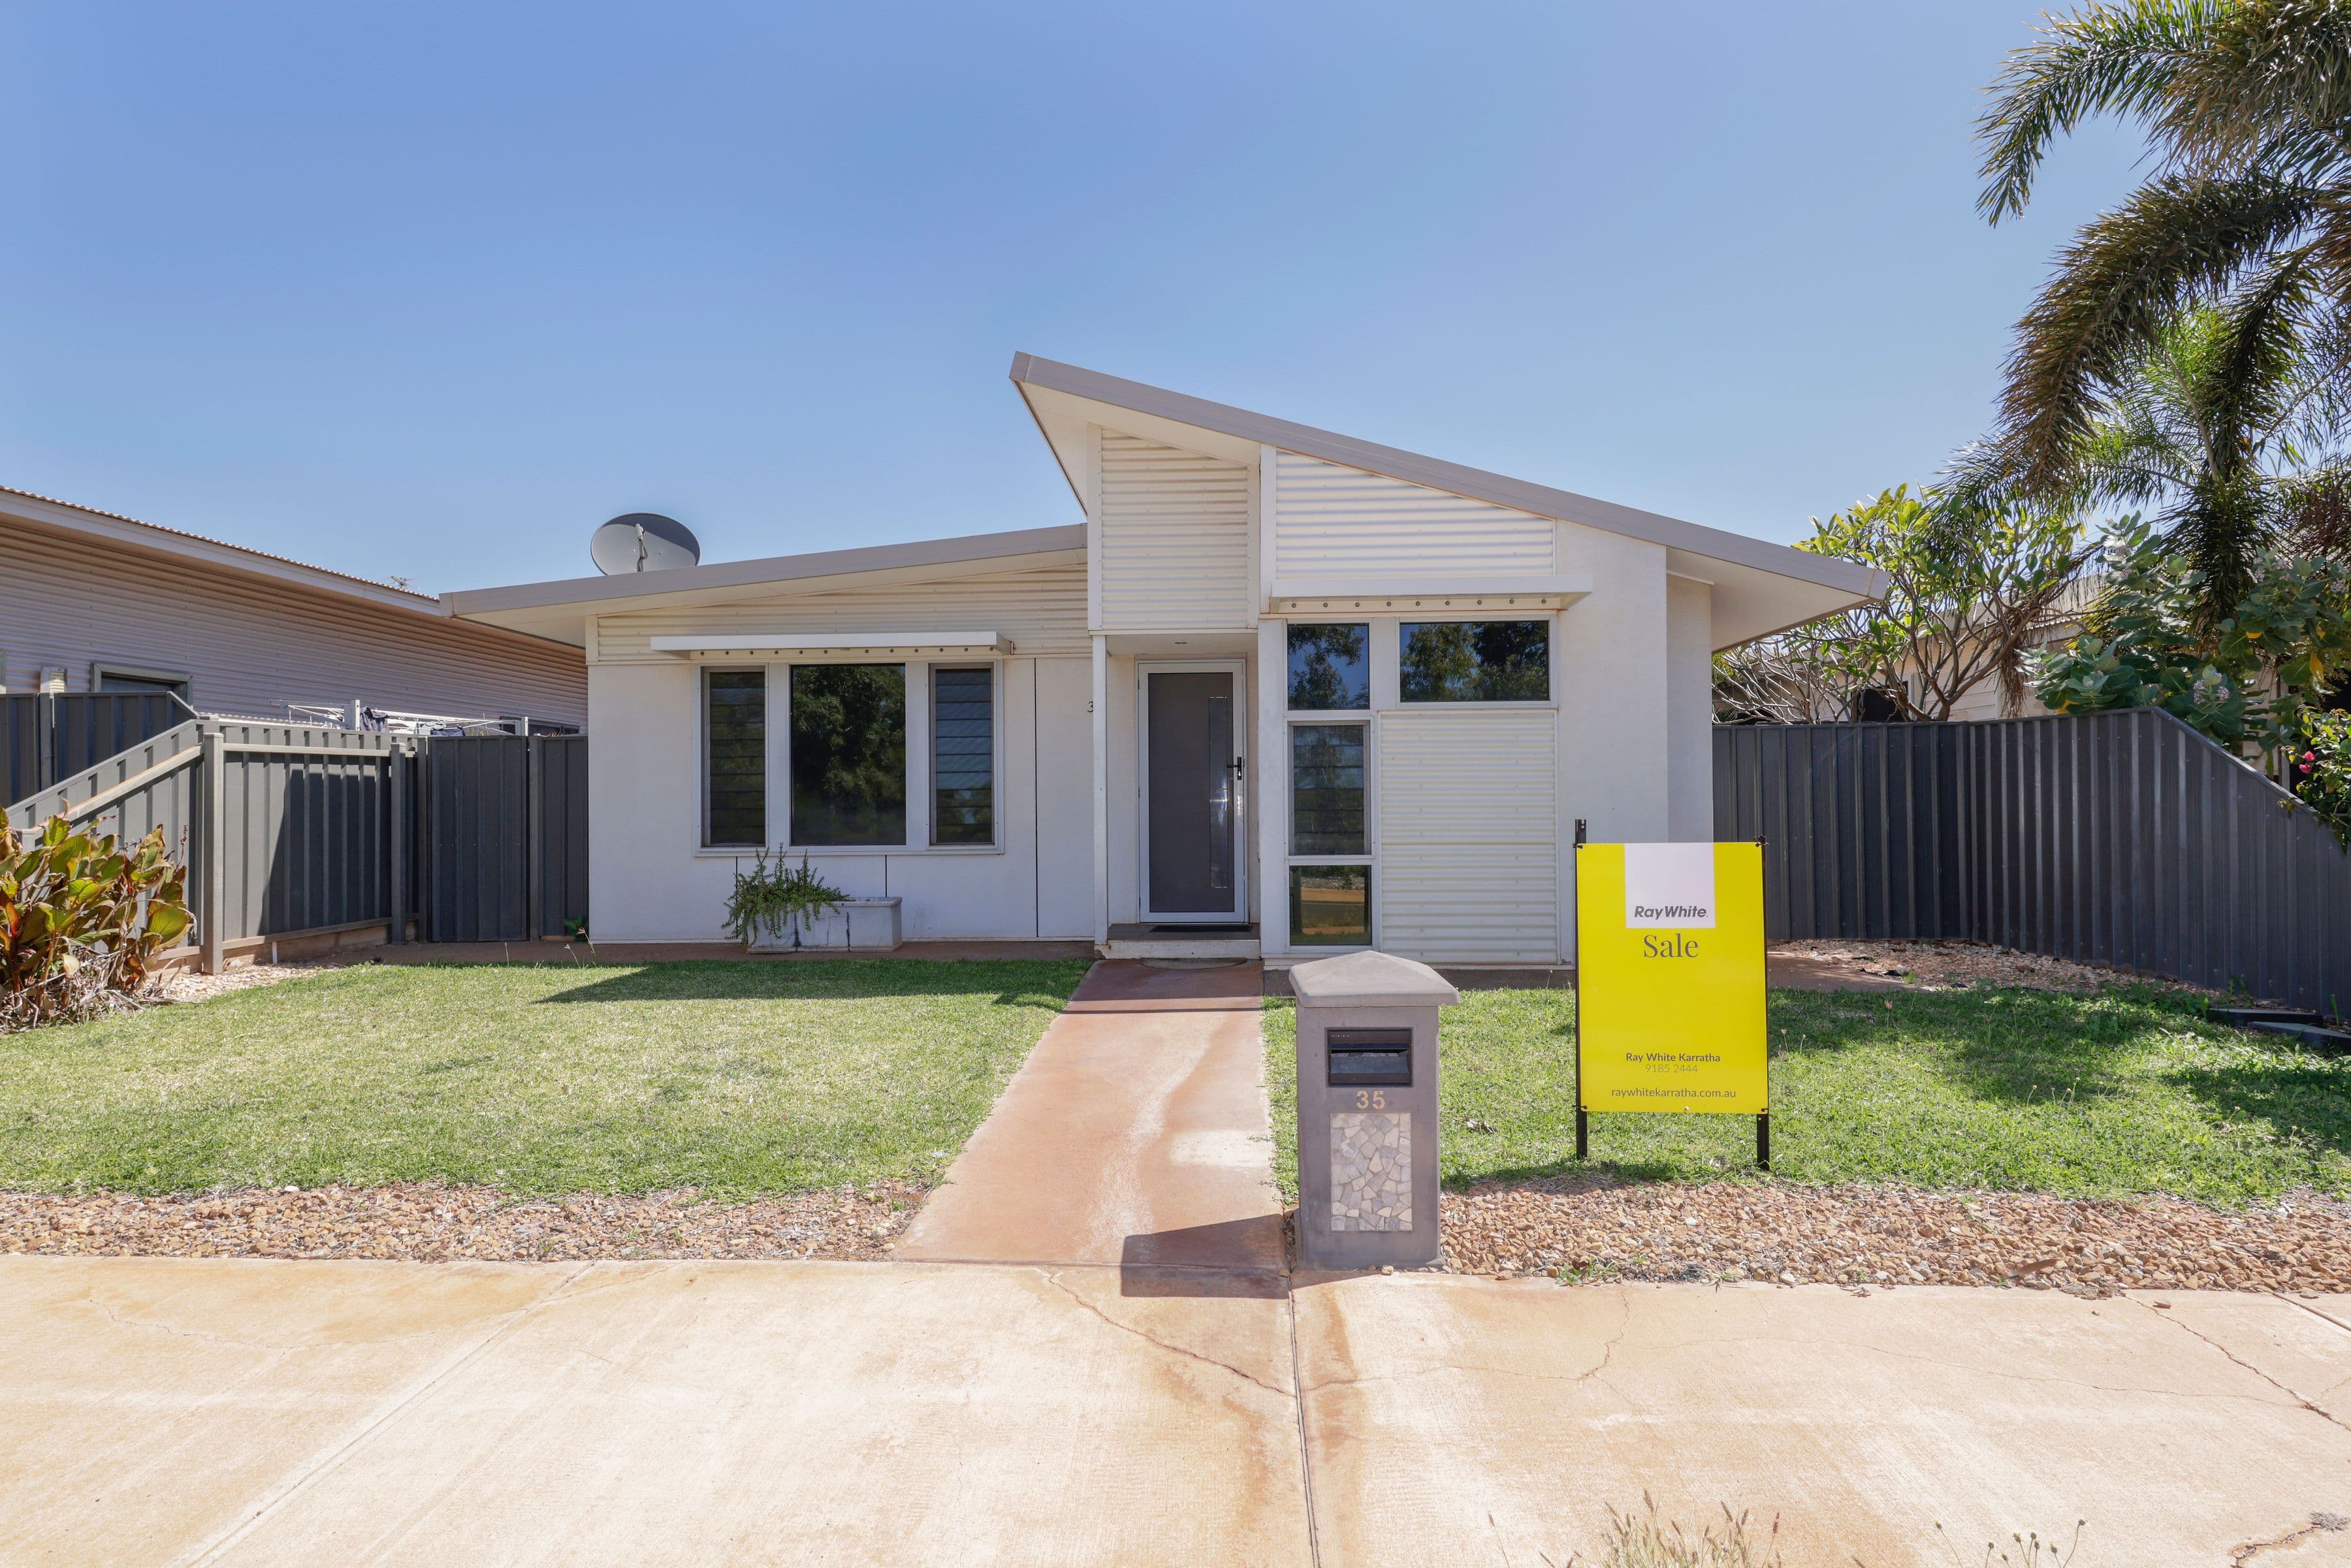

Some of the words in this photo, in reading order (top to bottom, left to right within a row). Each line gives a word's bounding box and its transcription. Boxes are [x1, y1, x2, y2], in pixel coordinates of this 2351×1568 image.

[1635, 906, 1663, 920] Ray
[1665, 906, 1706, 918] White
[1644, 933, 1699, 957] Sale
[1626, 1053, 1643, 1063] Ray
[1679, 1053, 1720, 1062] Karratha
[1646, 1064, 1670, 1073] 9185
[1674, 1064, 1698, 1073] 2444
[1612, 1087, 1736, 1098] raywhitekarratha.com.au
[1356, 1091, 1385, 1110] 35
